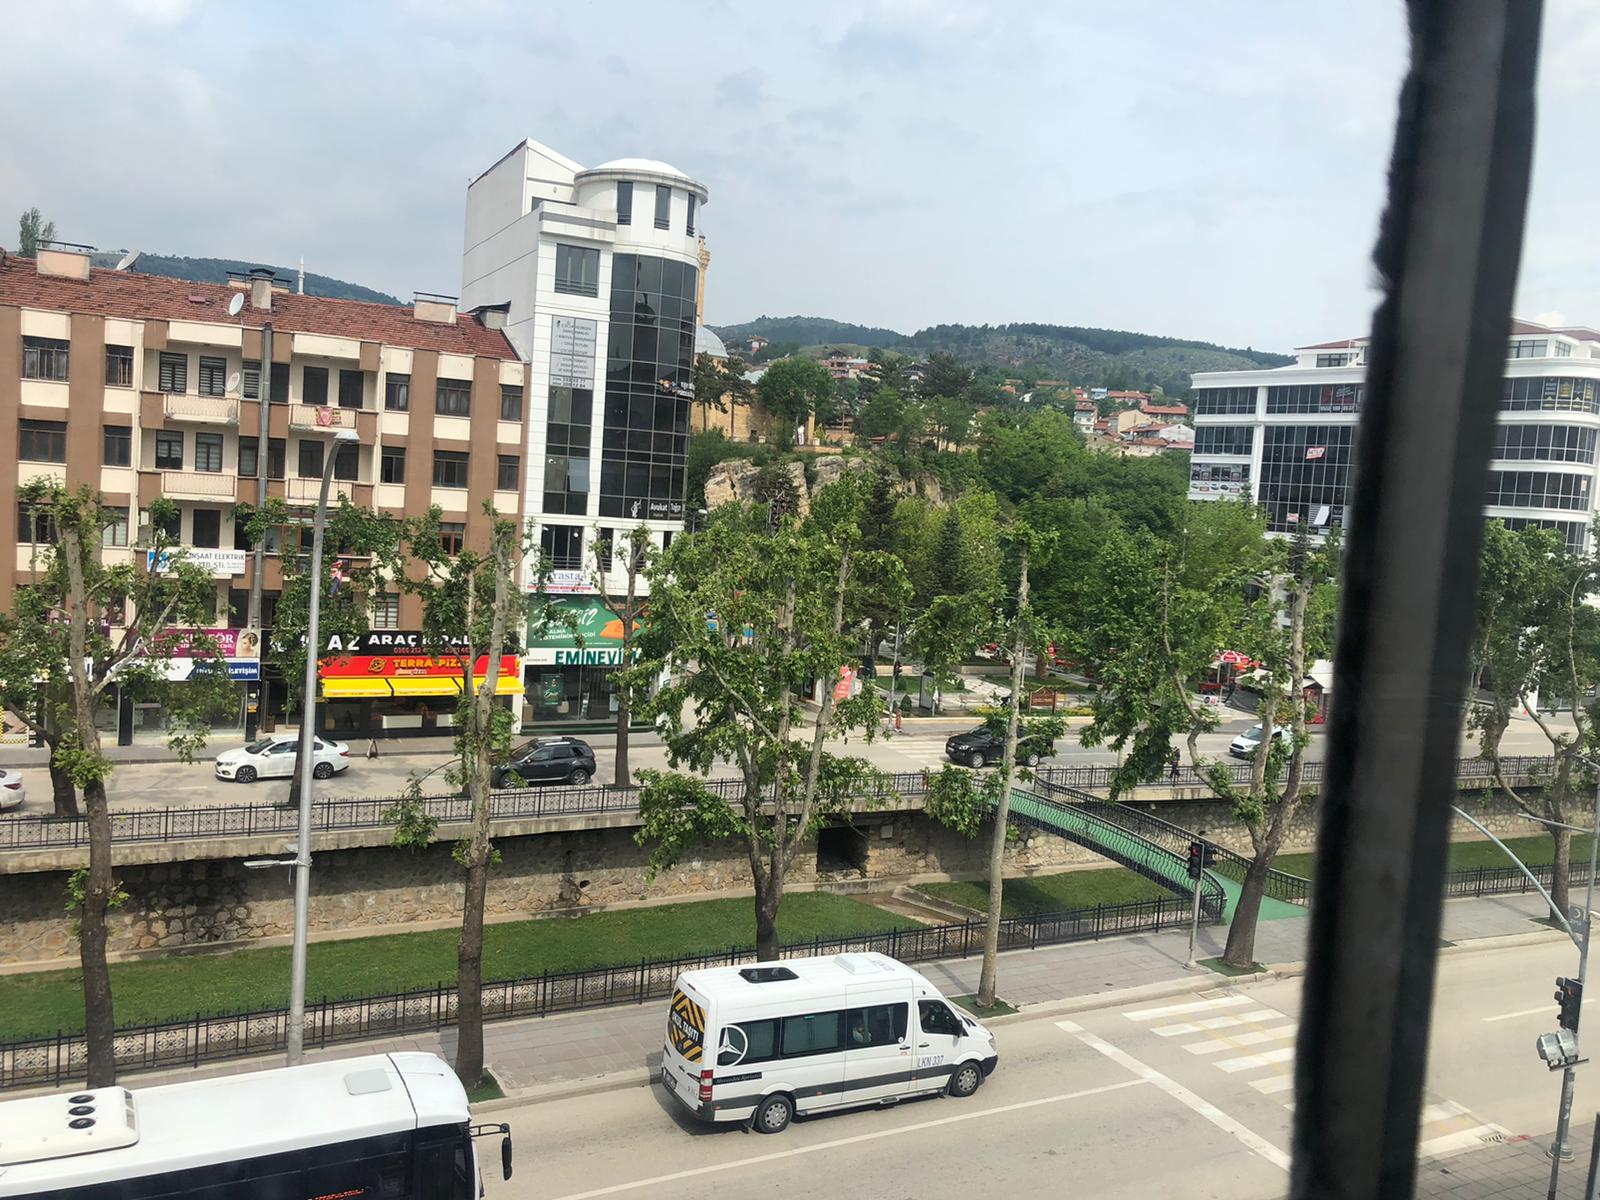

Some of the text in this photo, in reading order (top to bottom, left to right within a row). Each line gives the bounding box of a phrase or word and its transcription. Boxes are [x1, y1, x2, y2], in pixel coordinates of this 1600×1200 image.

[547, 572, 582, 581] rasta
[368, 634, 417, 647] ARAÇ
[555, 647, 638, 667] EMİNEVİ
[393, 659, 433, 668] TERRA
